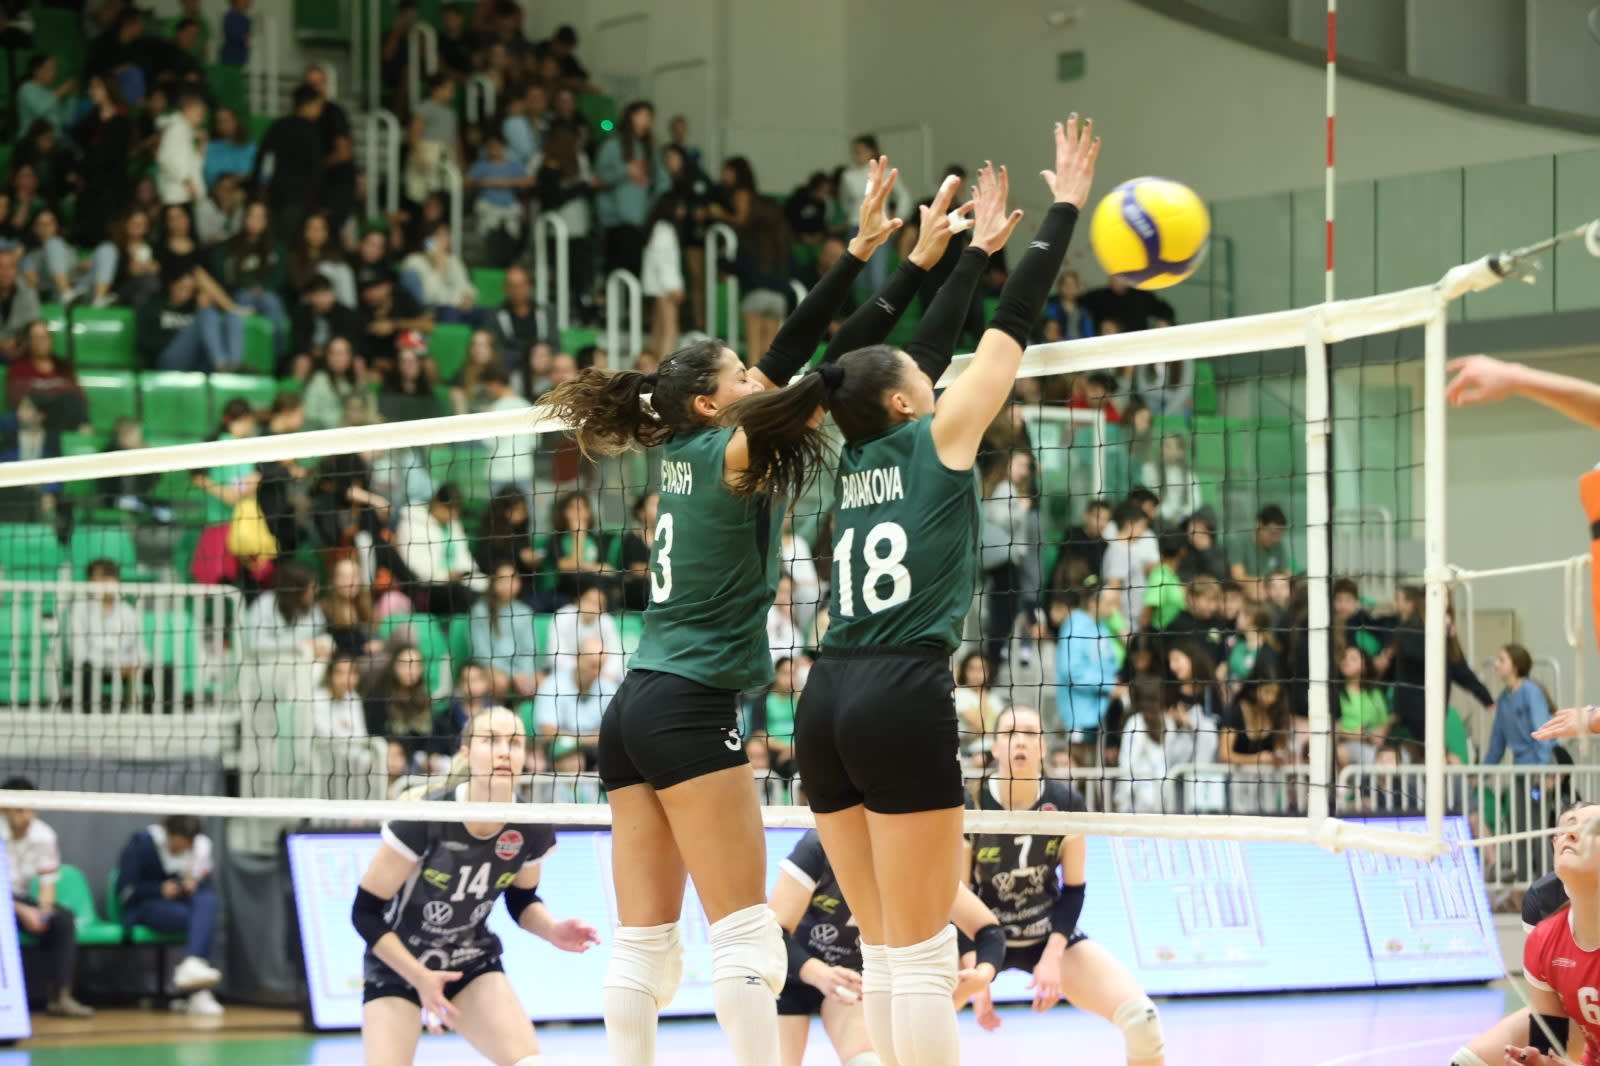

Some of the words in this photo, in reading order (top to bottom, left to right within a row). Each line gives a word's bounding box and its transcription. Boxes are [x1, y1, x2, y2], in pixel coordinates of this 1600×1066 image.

[651, 512, 674, 603] 3
[833, 521, 912, 617] 18
[1013, 834, 1032, 869] 7
[450, 862, 492, 902] 14
[1577, 986, 1600, 1025] 6
